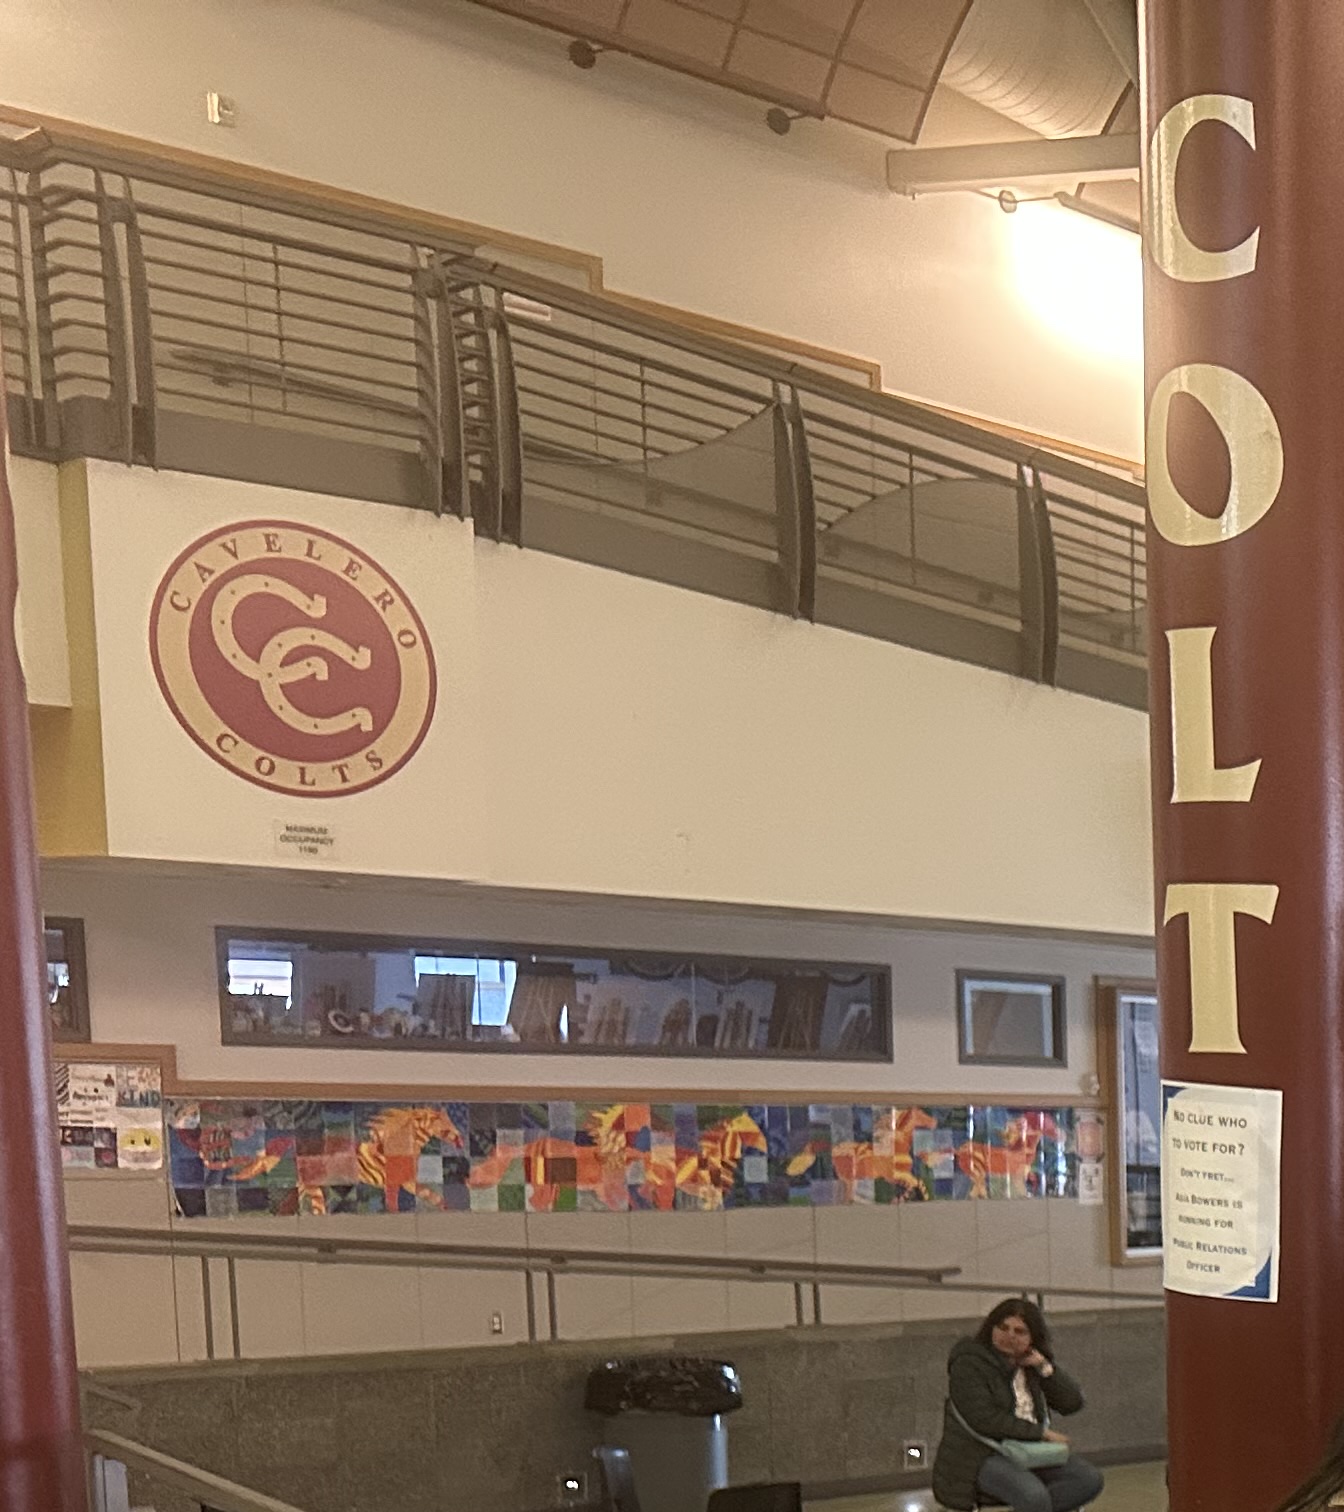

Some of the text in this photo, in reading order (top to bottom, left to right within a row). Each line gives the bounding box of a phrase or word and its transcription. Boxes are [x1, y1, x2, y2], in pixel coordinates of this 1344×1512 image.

[1146, 94, 1284, 1053] COLT
[170, 533, 417, 650] CAVELERO
[216, 733, 383, 786] COLTS
[1174, 1110, 1248, 1129] NO CLUE WHO
[1172, 1137, 1182, 1149] TO
[1184, 1139, 1208, 1153] VOTE
[1215, 1219, 1234, 1230] FOR
[1196, 1241, 1248, 1256] RELATIONS
